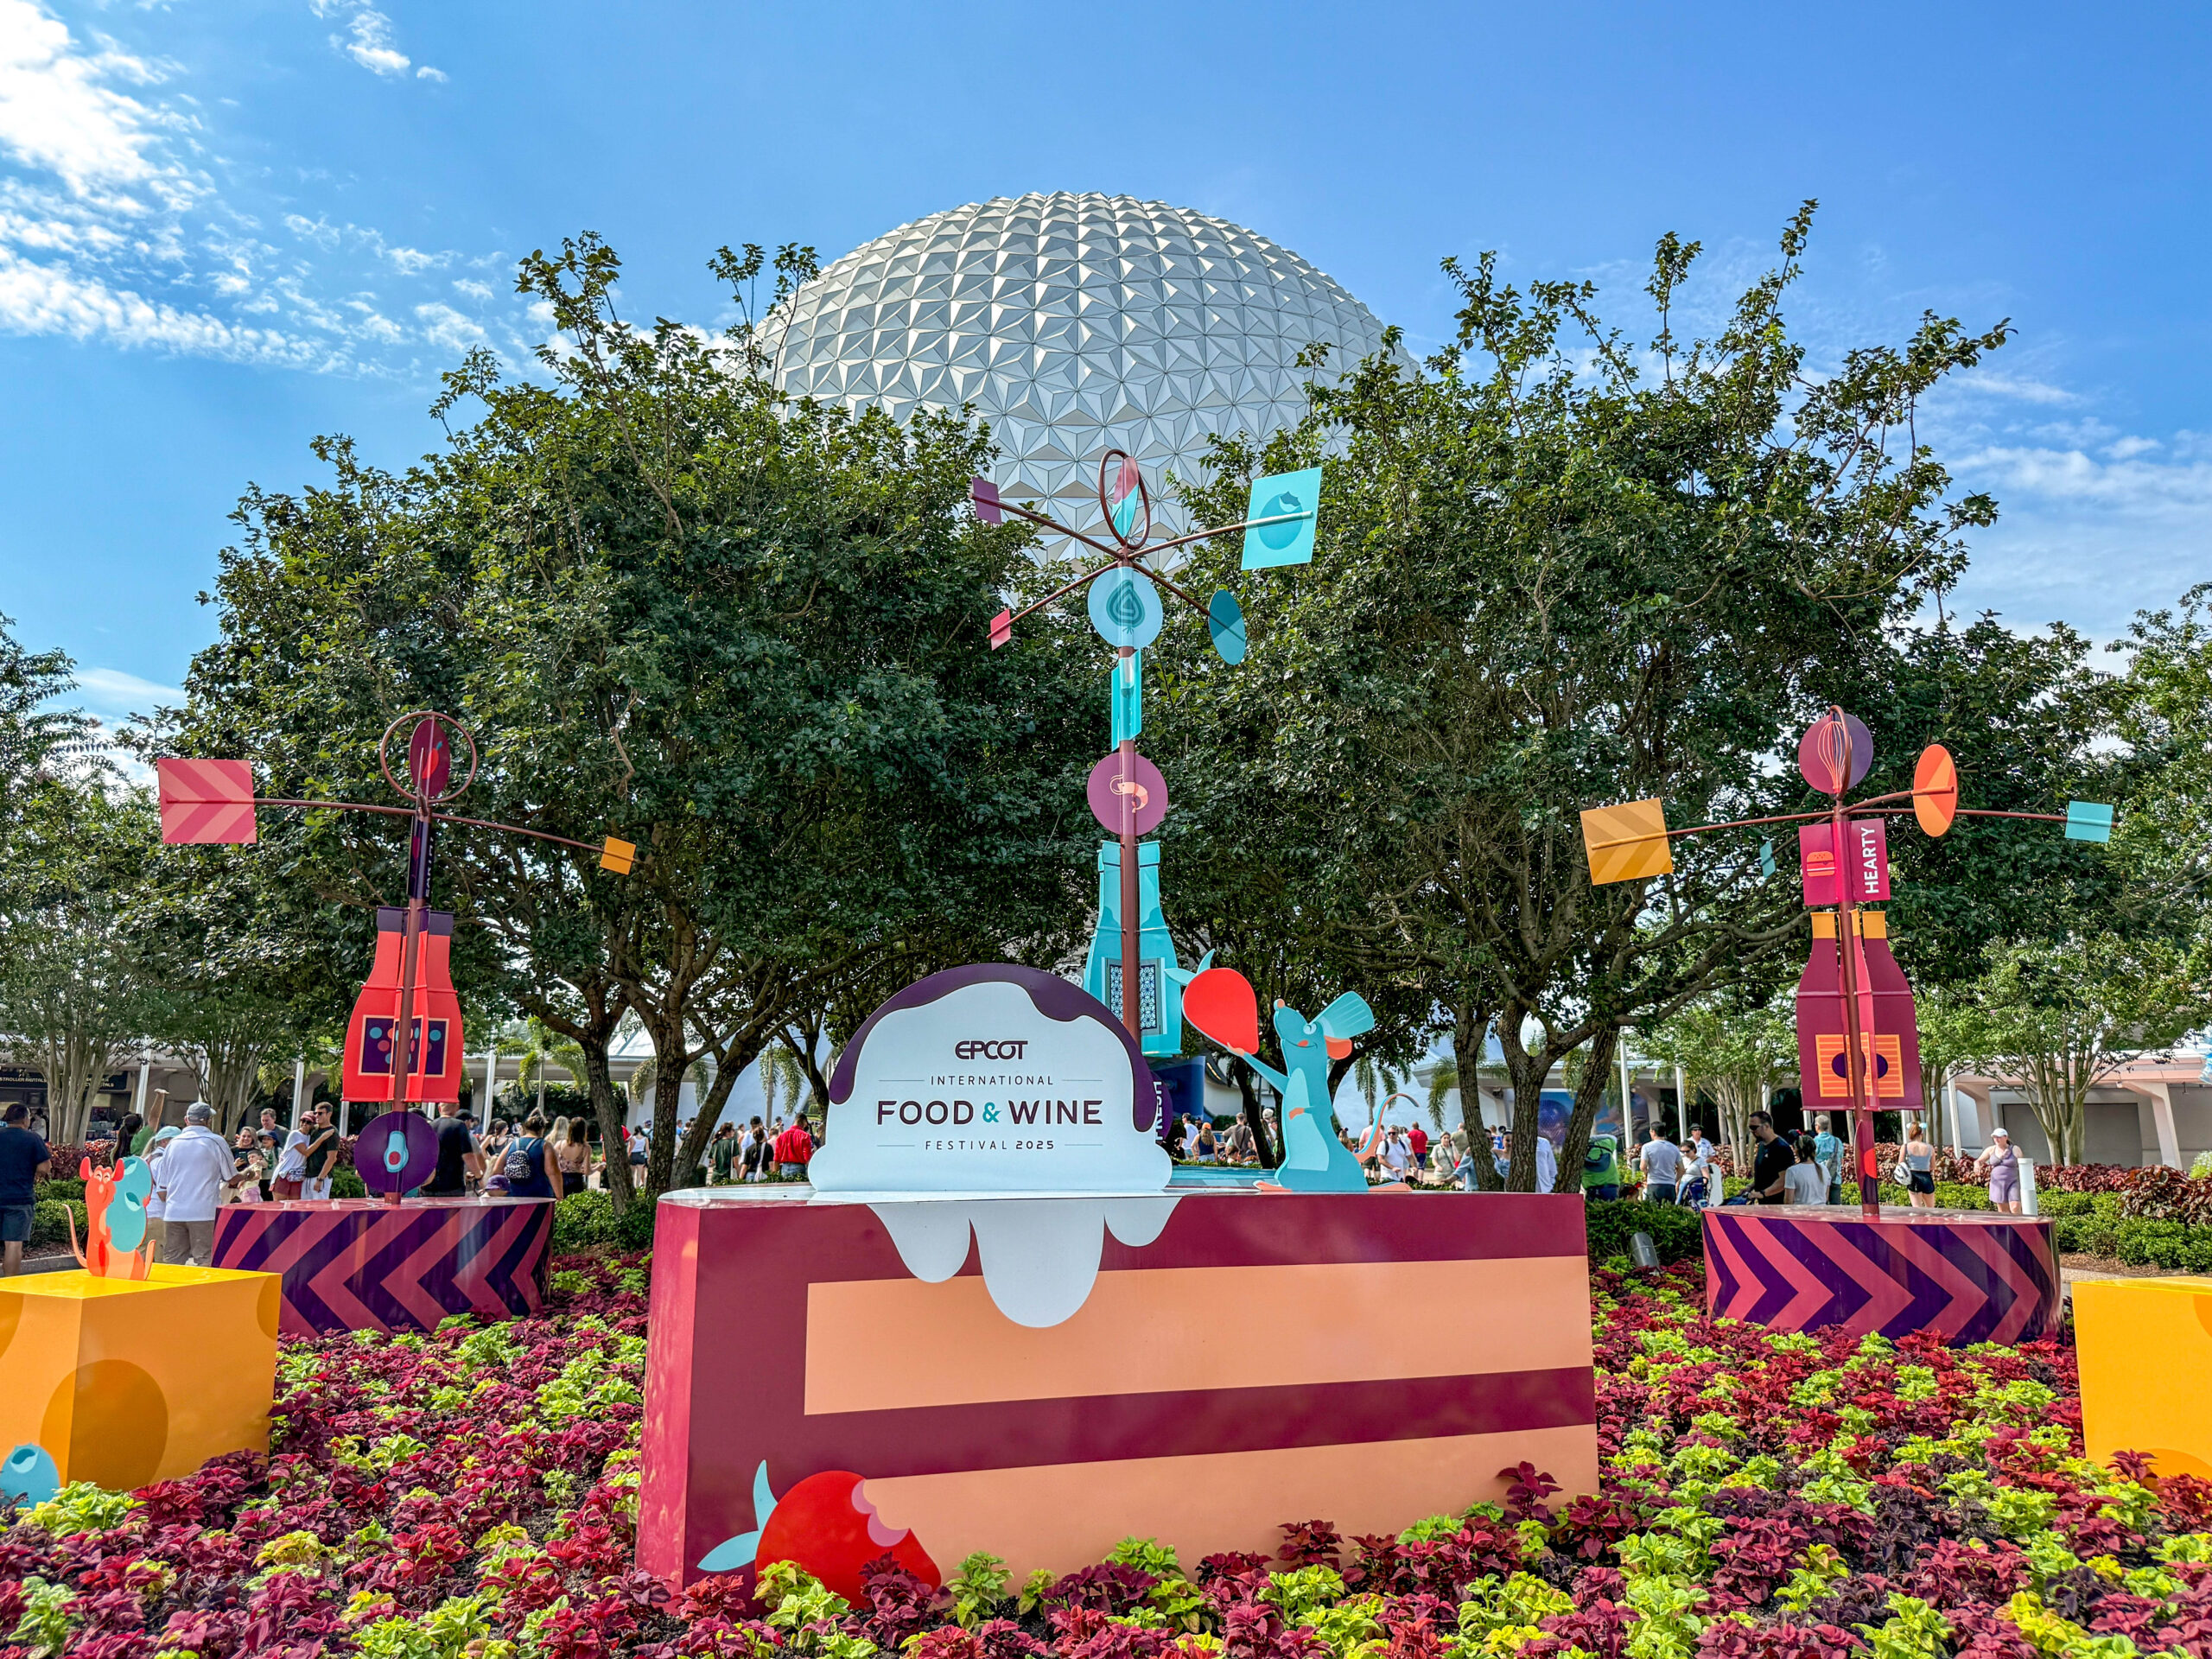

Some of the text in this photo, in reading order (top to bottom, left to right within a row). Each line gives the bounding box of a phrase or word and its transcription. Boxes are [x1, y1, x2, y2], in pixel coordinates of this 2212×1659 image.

[1861, 827, 1879, 893] HEARTY
[955, 1040, 1028, 1059] EPCOT
[931, 1076, 1053, 1085] INTERNATIONAL
[877, 1100, 1103, 1124] FOOD & WINE
[925, 1141, 1054, 1150] FESTIVAL 2025
